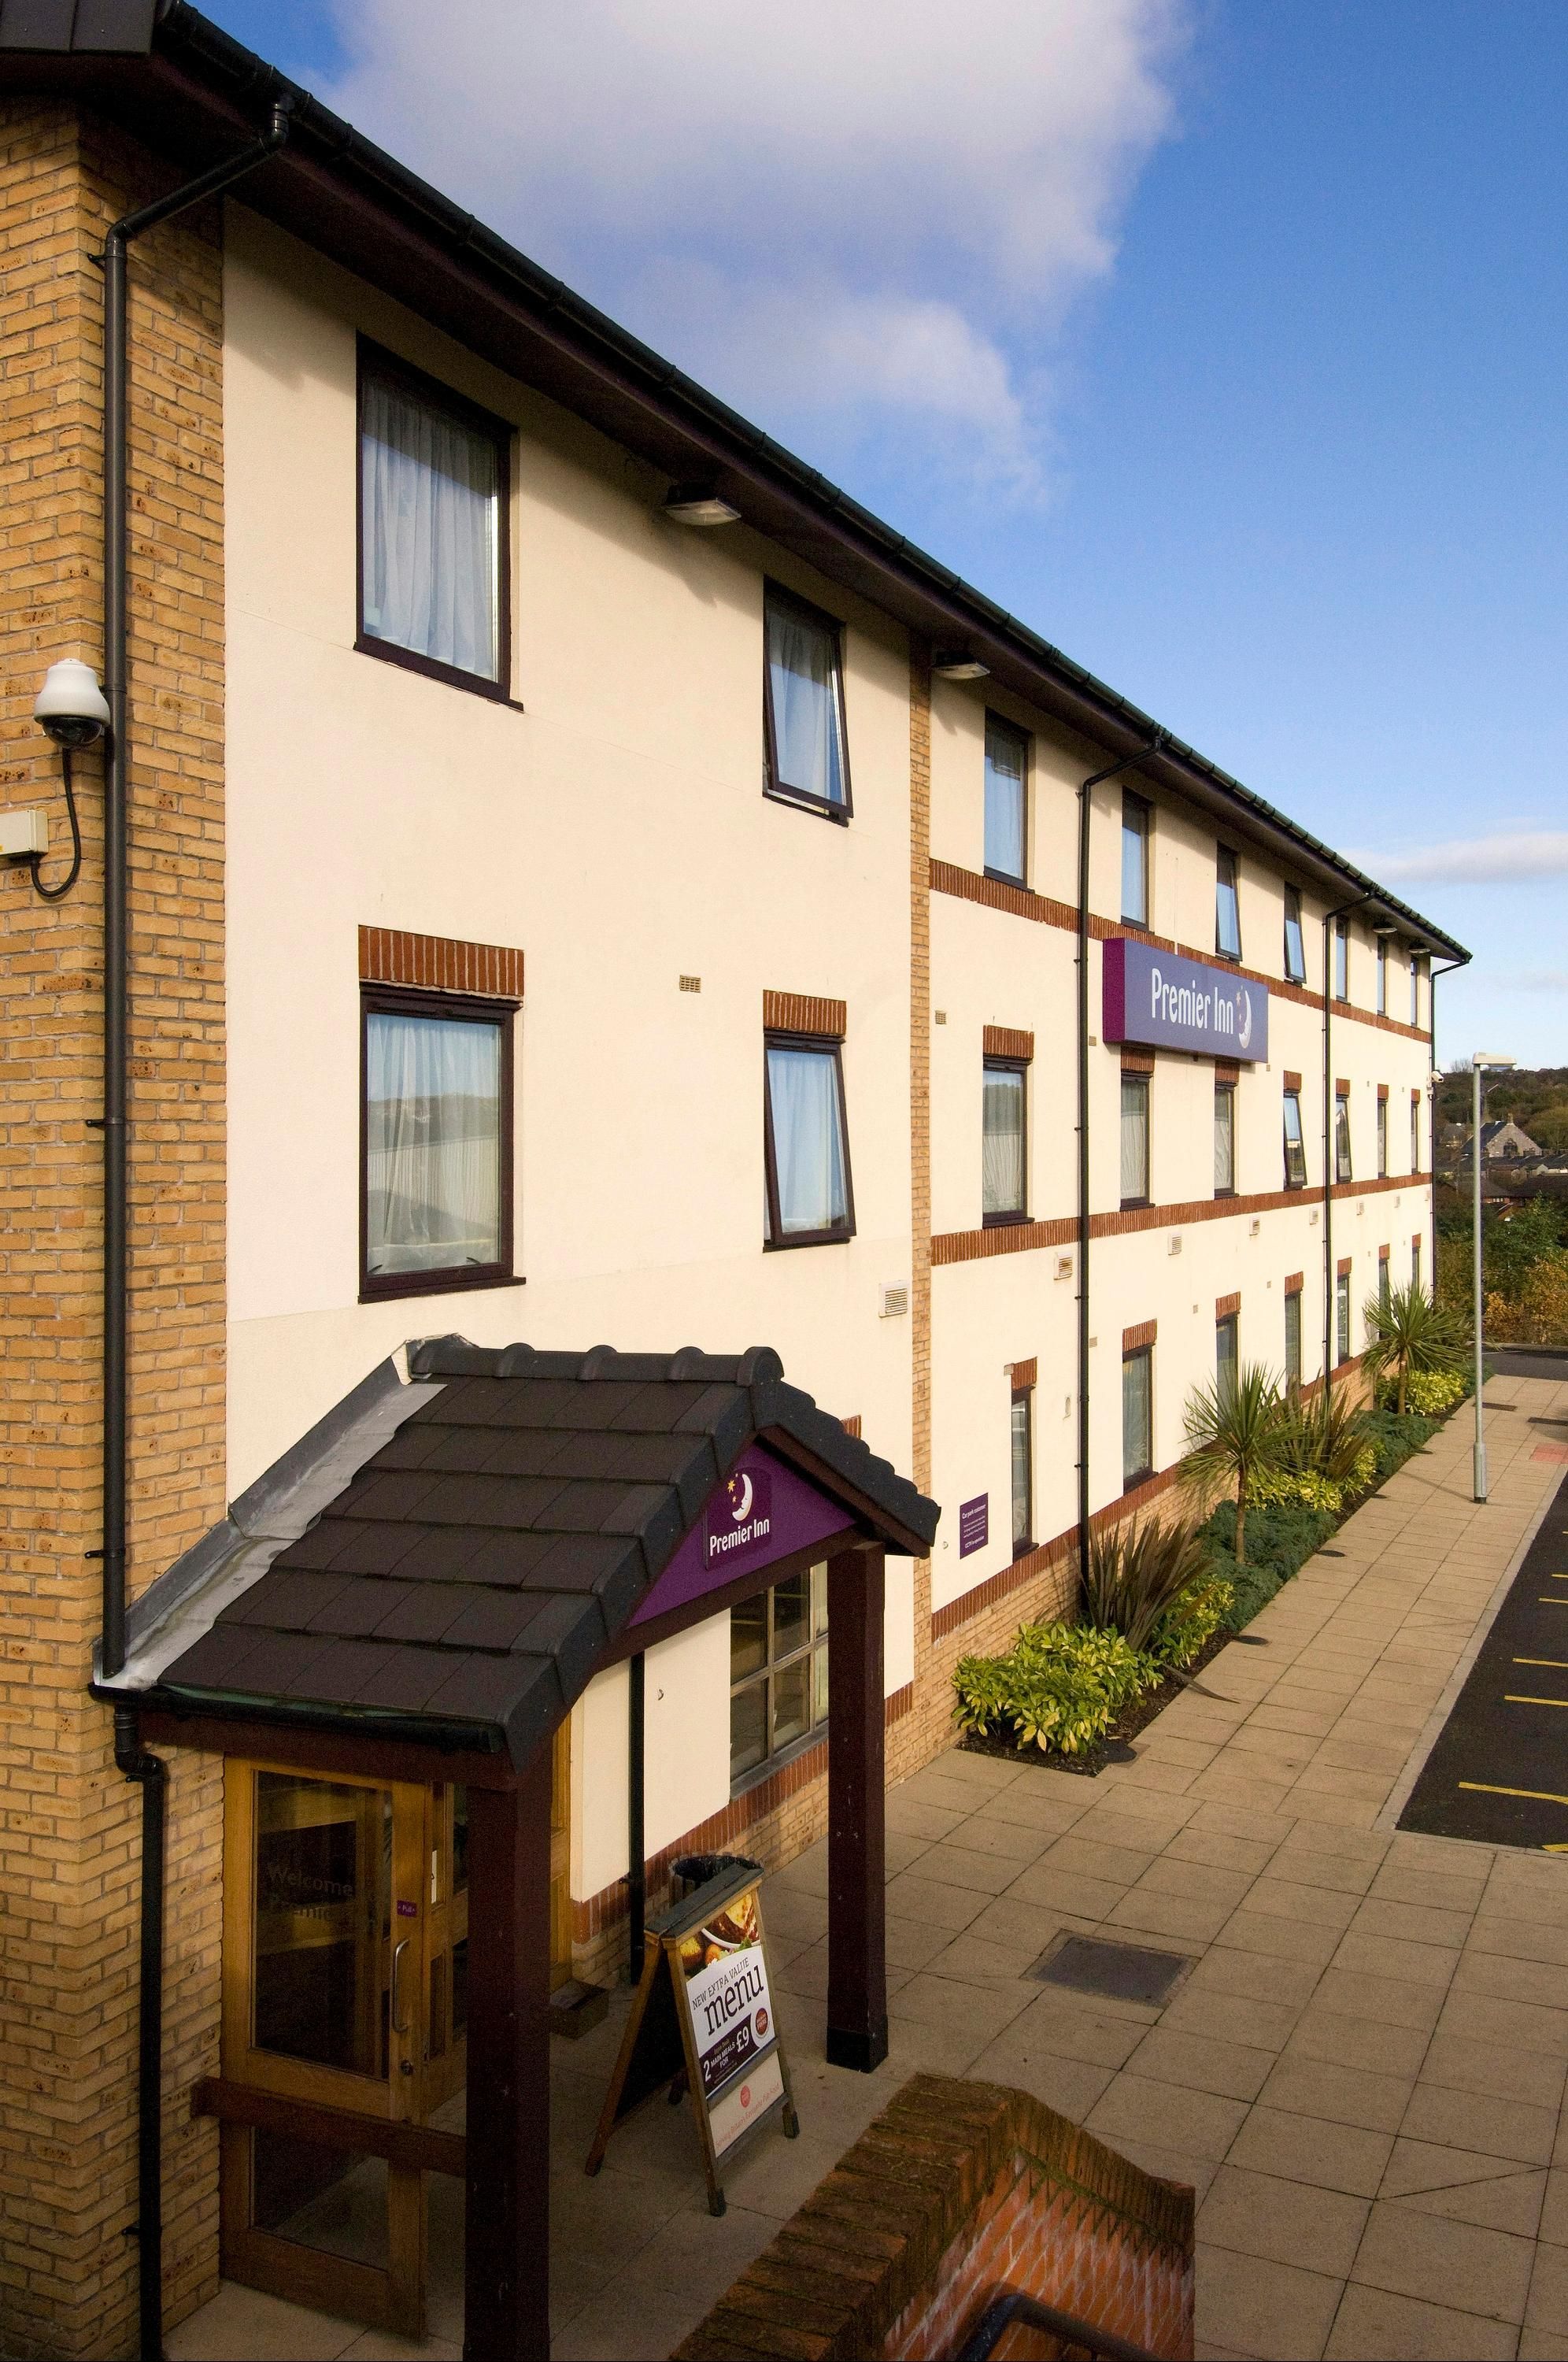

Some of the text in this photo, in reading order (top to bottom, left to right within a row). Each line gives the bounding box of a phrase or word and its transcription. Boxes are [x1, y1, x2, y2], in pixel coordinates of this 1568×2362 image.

[1152, 968, 1233, 1035] Premier Inn
[710, 1519, 770, 1556] Premier Inn
[268, 1862, 353, 1897] Welcome
[692, 1957, 749, 2010] NEW EXTRA VALUE
[704, 1965, 764, 2036] menu
[704, 2060, 712, 2082] 2
[711, 2054, 722, 2068] MAIN
[721, 2042, 735, 2058] MEALS
[737, 2026, 749, 2053] £9
[719, 2056, 729, 2068] FOR
